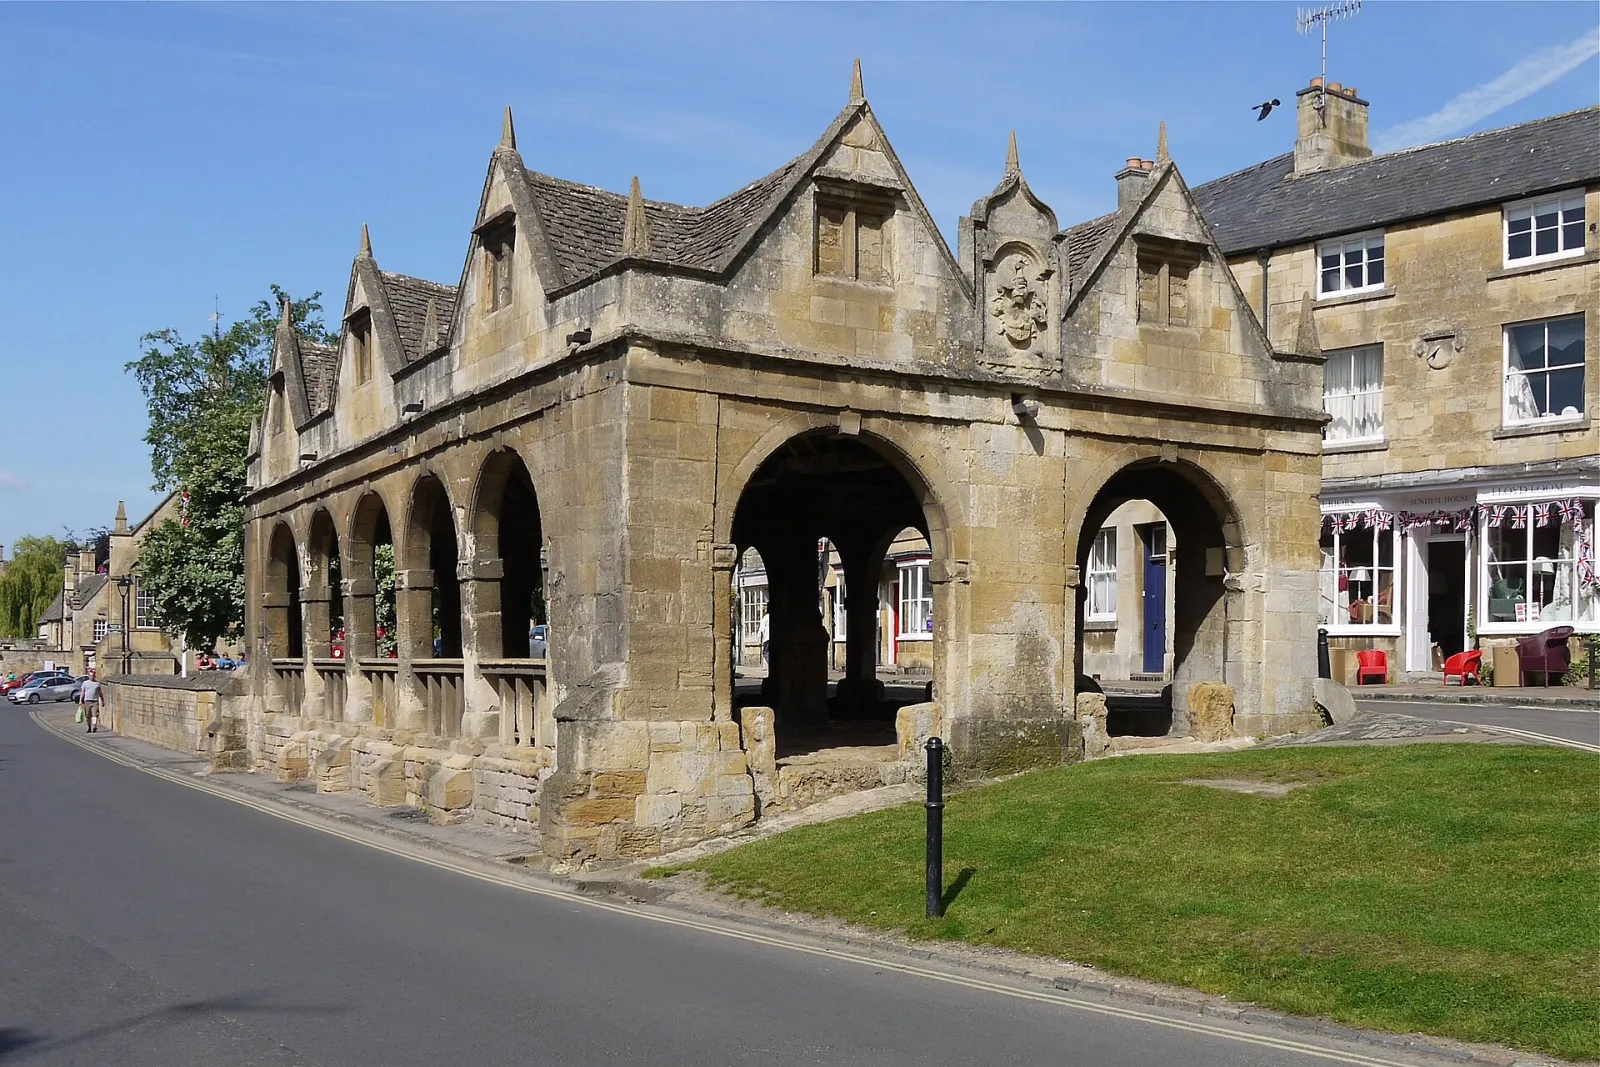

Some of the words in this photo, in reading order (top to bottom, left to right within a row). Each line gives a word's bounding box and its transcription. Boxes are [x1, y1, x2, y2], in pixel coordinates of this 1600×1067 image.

[1492, 485, 1528, 496] LLOYD
[1530, 483, 1564, 494] LOOM
[1410, 497, 1442, 506] SUNDIAL
[1444, 494, 1469, 503] HOUSE
